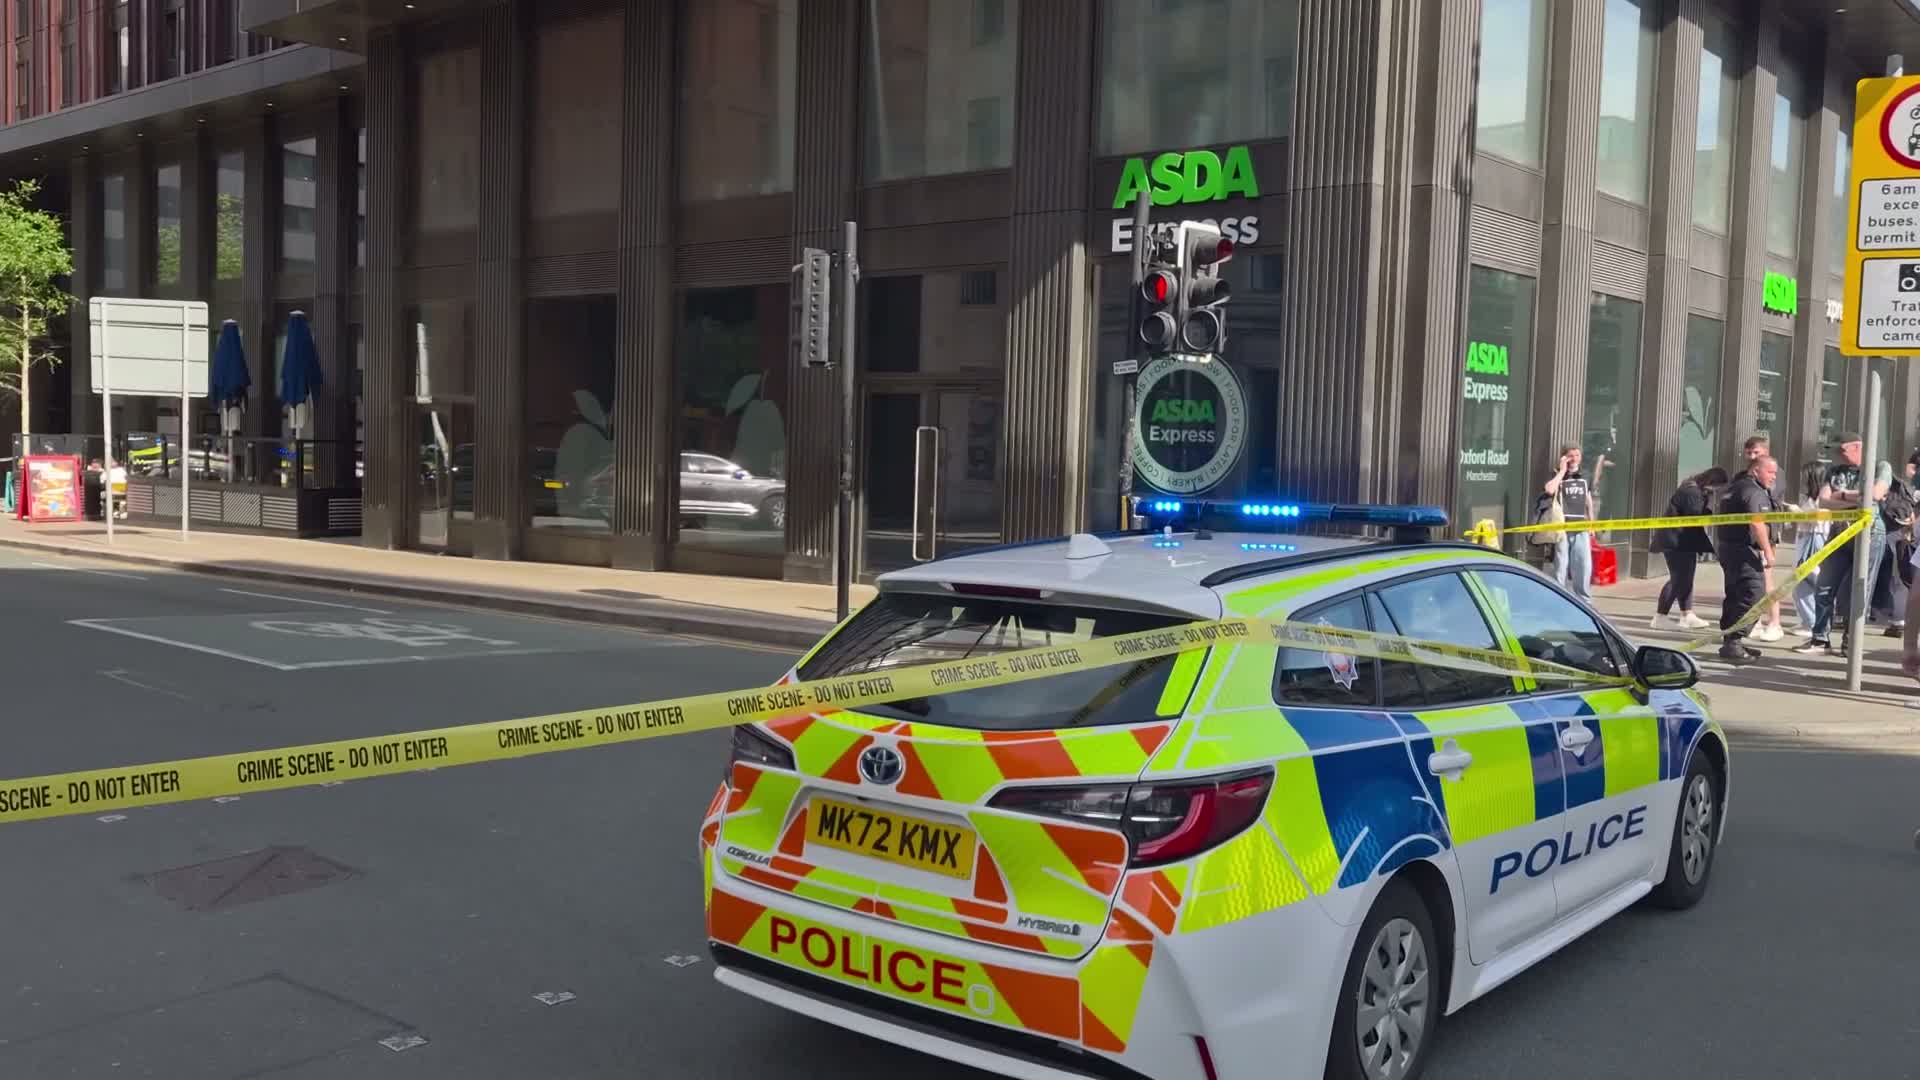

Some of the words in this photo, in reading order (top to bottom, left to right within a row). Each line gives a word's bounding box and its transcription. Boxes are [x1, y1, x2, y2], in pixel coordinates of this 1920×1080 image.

[1112, 146, 1259, 209] ASDA
[1882, 184, 1916, 195] 6am
[1864, 231, 1916, 245] permit
[1868, 216, 1918, 227] buses.
[1466, 341, 1509, 376] ASDA
[1463, 377, 1509, 403] Express
[1151, 399, 1216, 423] ASDA
[1150, 426, 1215, 445] Express
[1488, 449, 1509, 465] Road
[1113, 638, 1144, 656] CRIME
[1145, 633, 1180, 650] SCENE
[1184, 629, 1200, 643] DO
[1201, 626, 1219, 641] NOT
[1219, 622, 1249, 637] ENTER
[930, 667, 965, 687] CRIME
[966, 661, 1001, 681] SCENE
[1008, 658, 1024, 674] DO
[1027, 654, 1047, 671] NOT
[1049, 648, 1082, 667] ENTER
[727, 694, 765, 716] CRIME
[767, 689, 805, 711] SCENE
[814, 686, 831, 704] DO
[834, 682, 856, 702] NOT
[859, 676, 894, 696] ENTER
[498, 725, 540, 749] CRIME
[542, 719, 585, 743] SCENE
[596, 715, 614, 735] DO
[617, 710, 641, 733] NOT
[645, 705, 684, 728] ENTER
[237, 757, 284, 783] CRIME
[288, 751, 335, 776] SCENE
[349, 746, 369, 769] DO
[372, 742, 400, 766] NOT
[404, 737, 449, 762] ENTER
[0, 785, 52, 813] SCENE
[68, 780, 90, 804] DO
[95, 776, 126, 801] NOT
[131, 770, 180, 796] ENTER
[817, 804, 892, 852] MK72
[898, 822, 961, 869] KMX
[1489, 805, 1647, 895] POLICE
[770, 916, 967, 1006] POLICE
